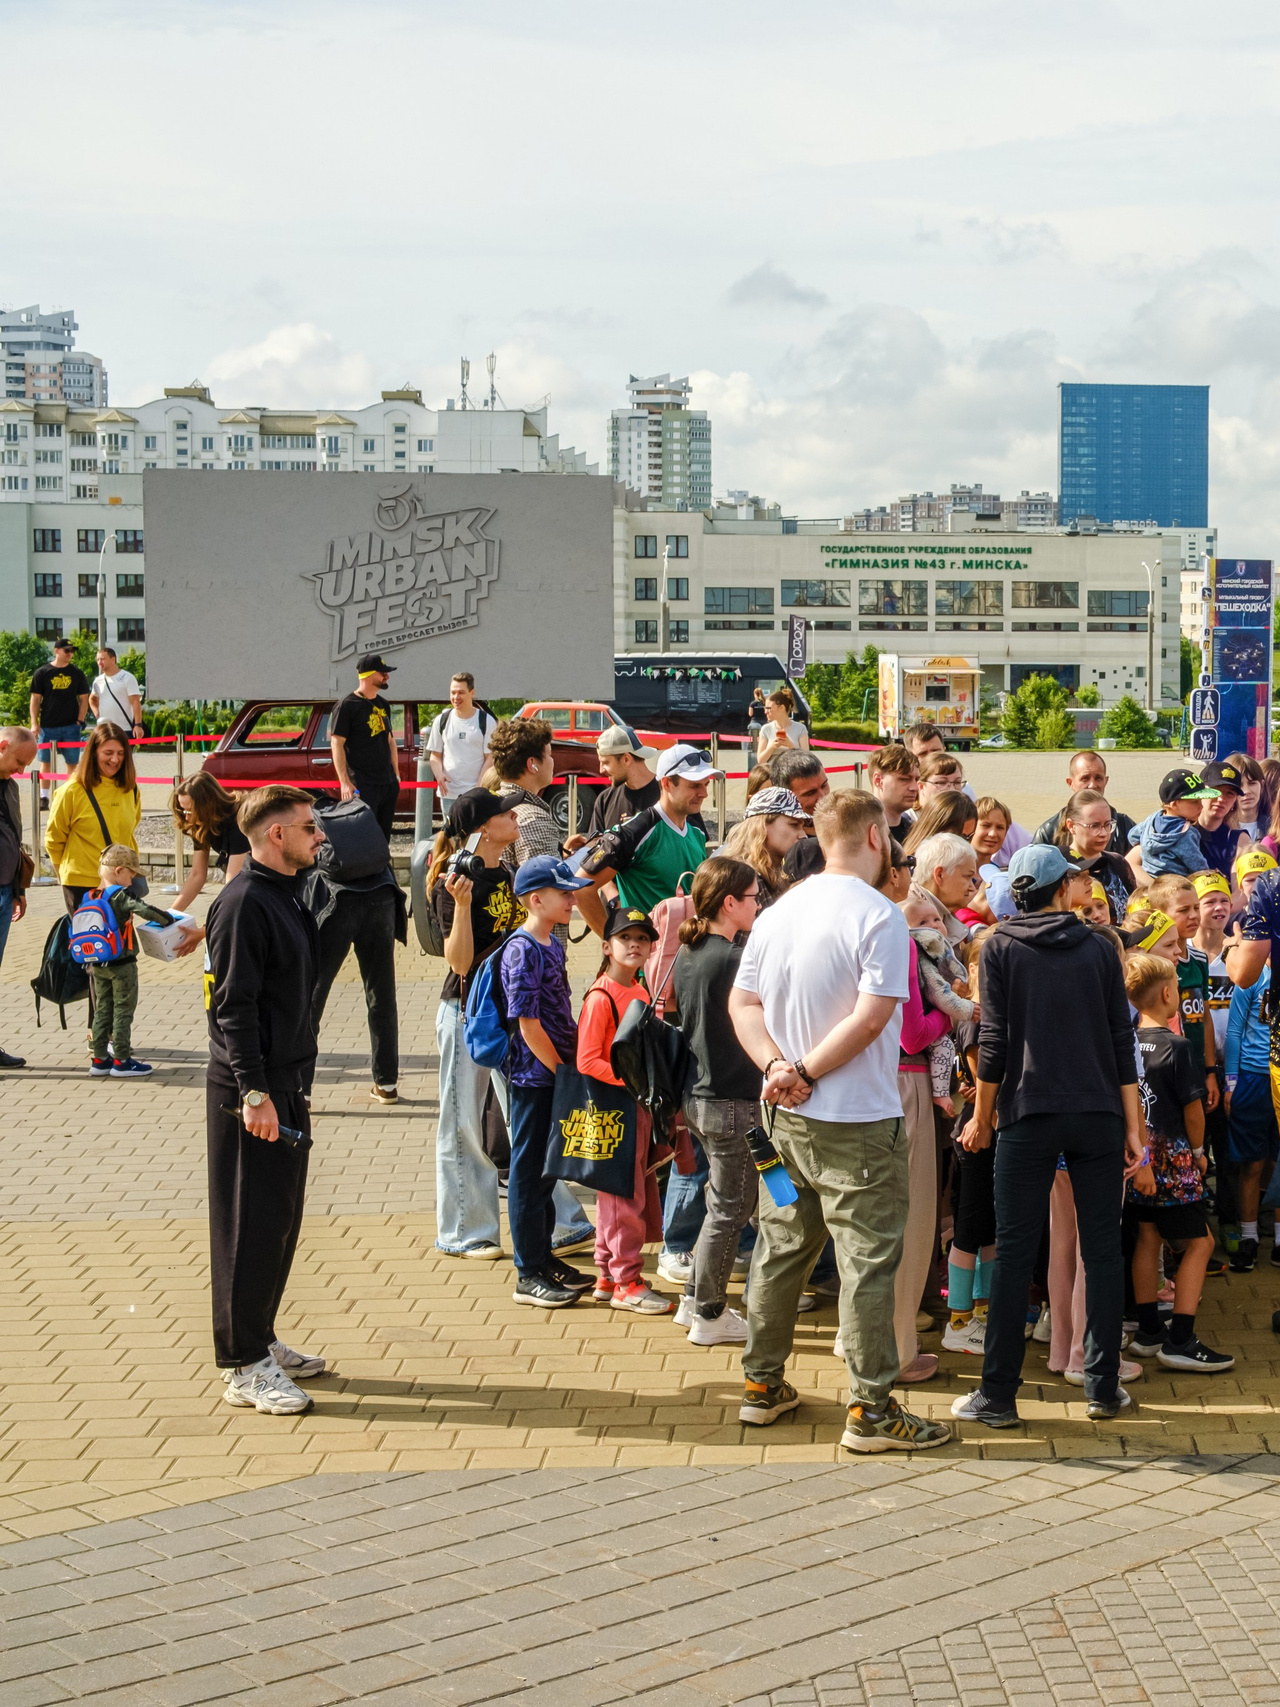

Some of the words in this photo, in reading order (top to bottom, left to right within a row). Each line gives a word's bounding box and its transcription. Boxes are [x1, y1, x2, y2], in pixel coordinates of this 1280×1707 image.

[331, 510, 482, 571] MINSK
[820, 545, 905, 554] ГОСУДАРСТВЕННОЕ
[907, 545, 966, 555] УЧРЕЖДЕНИЕ
[968, 546, 1033, 555] ОБРАЗОВАНИЯ
[314, 541, 487, 607] URBAN
[824, 558, 910, 569] «ГИМНАЗИЯ
[914, 559, 946, 569] №43
[341, 578, 478, 650] FEST
[364, 637, 395, 650] ГОРОД
[396, 626, 436, 642] БРОСАЕТ
[437, 619, 469, 632] ВЫЗОВ
[565, 1122, 619, 1139] URBAN
[568, 1136, 613, 1153] FEST
